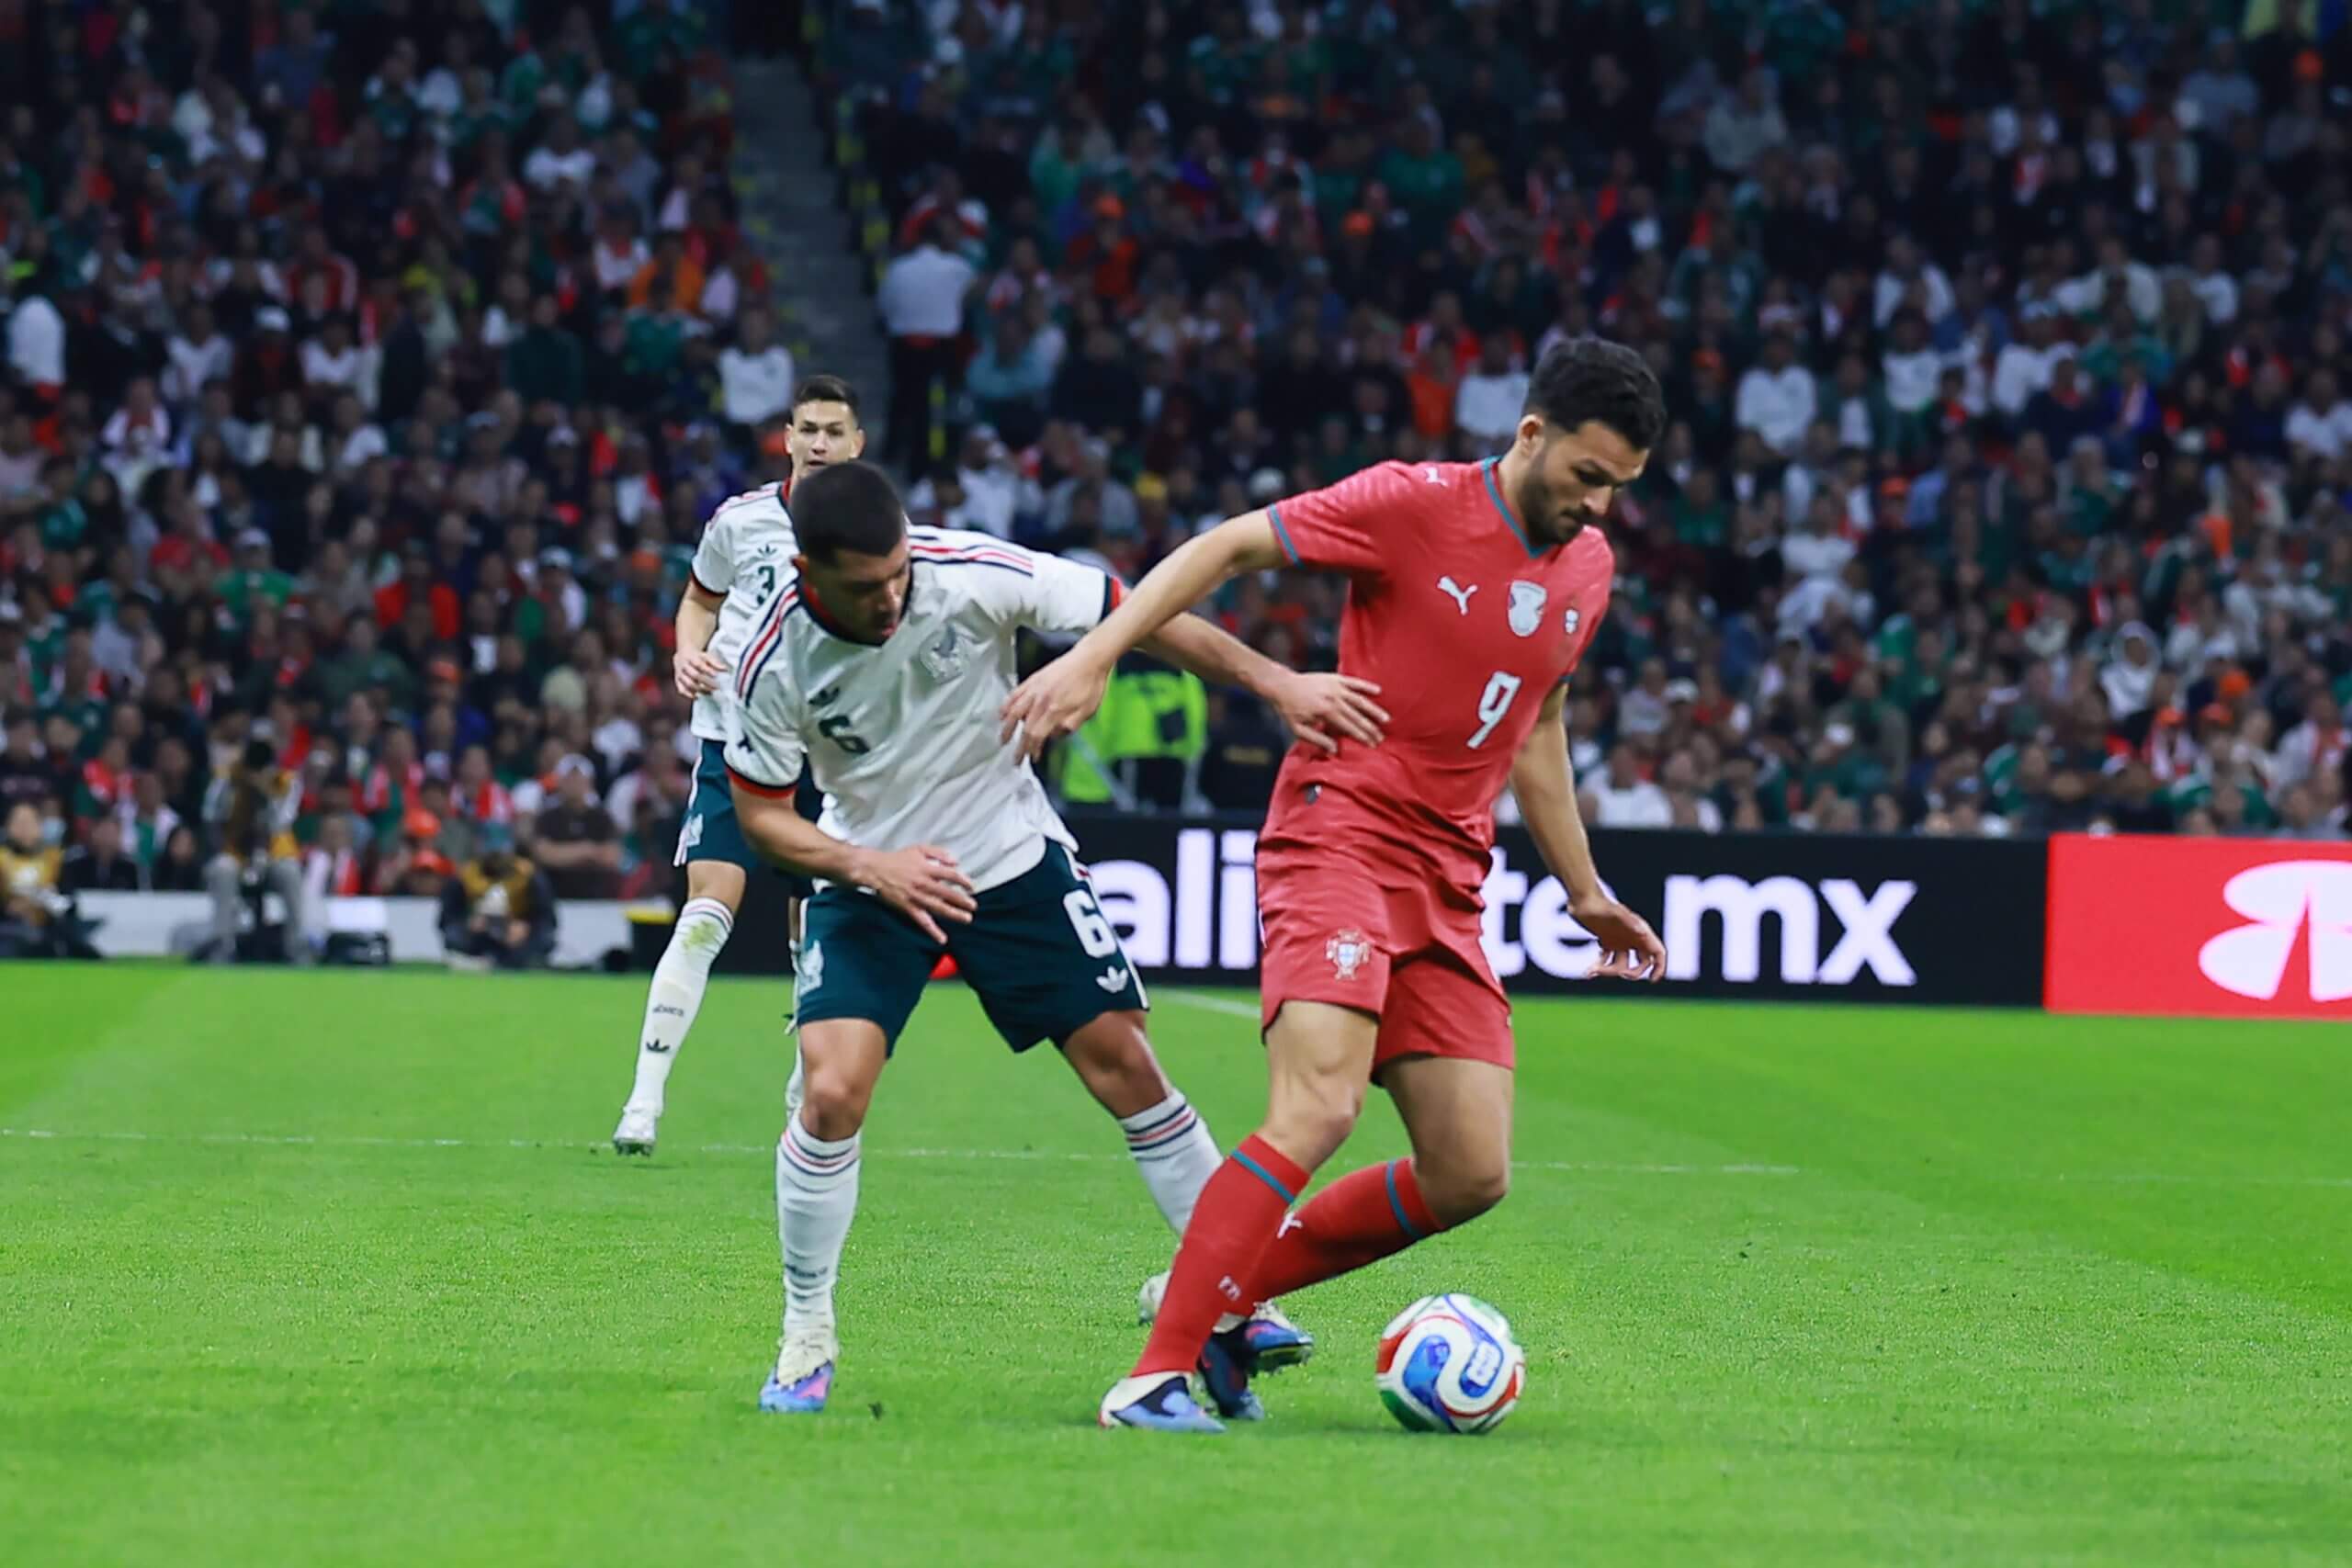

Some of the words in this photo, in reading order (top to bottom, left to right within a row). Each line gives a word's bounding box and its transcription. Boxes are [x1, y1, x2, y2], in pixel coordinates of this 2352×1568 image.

[757, 565, 775, 606] 3
[819, 716, 870, 754] 6
[1466, 671, 1521, 749] 9
[1063, 889, 1117, 959] 6
